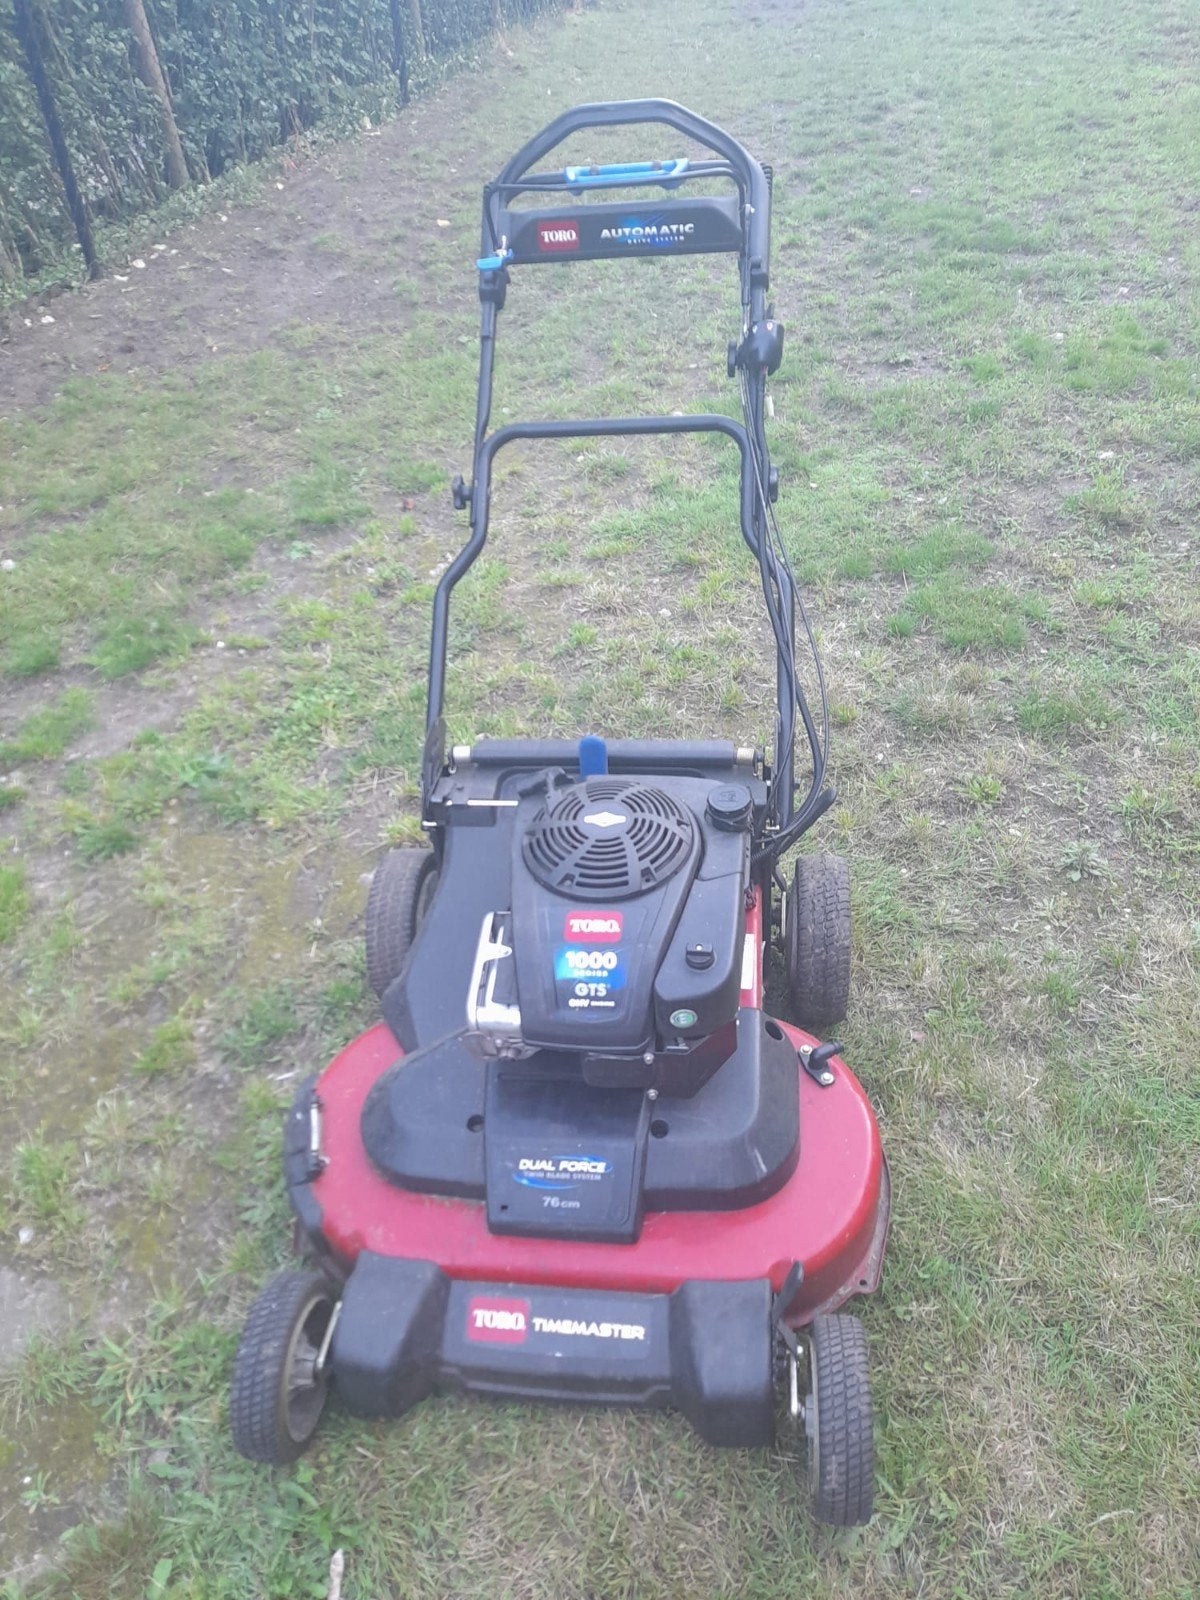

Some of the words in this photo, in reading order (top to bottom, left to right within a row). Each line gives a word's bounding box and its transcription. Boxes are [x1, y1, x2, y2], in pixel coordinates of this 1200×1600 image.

[541, 229, 577, 243] TORO
[600, 223, 695, 239] AUTOMATIC
[569, 919, 621, 933] TORO
[565, 951, 618, 970] 1000
[574, 982, 607, 997] GTS
[518, 1158, 556, 1171] DUAL
[559, 1160, 607, 1173] FORCE
[473, 1309, 526, 1331] TORO
[532, 1317, 646, 1340] TIMEMASTER
